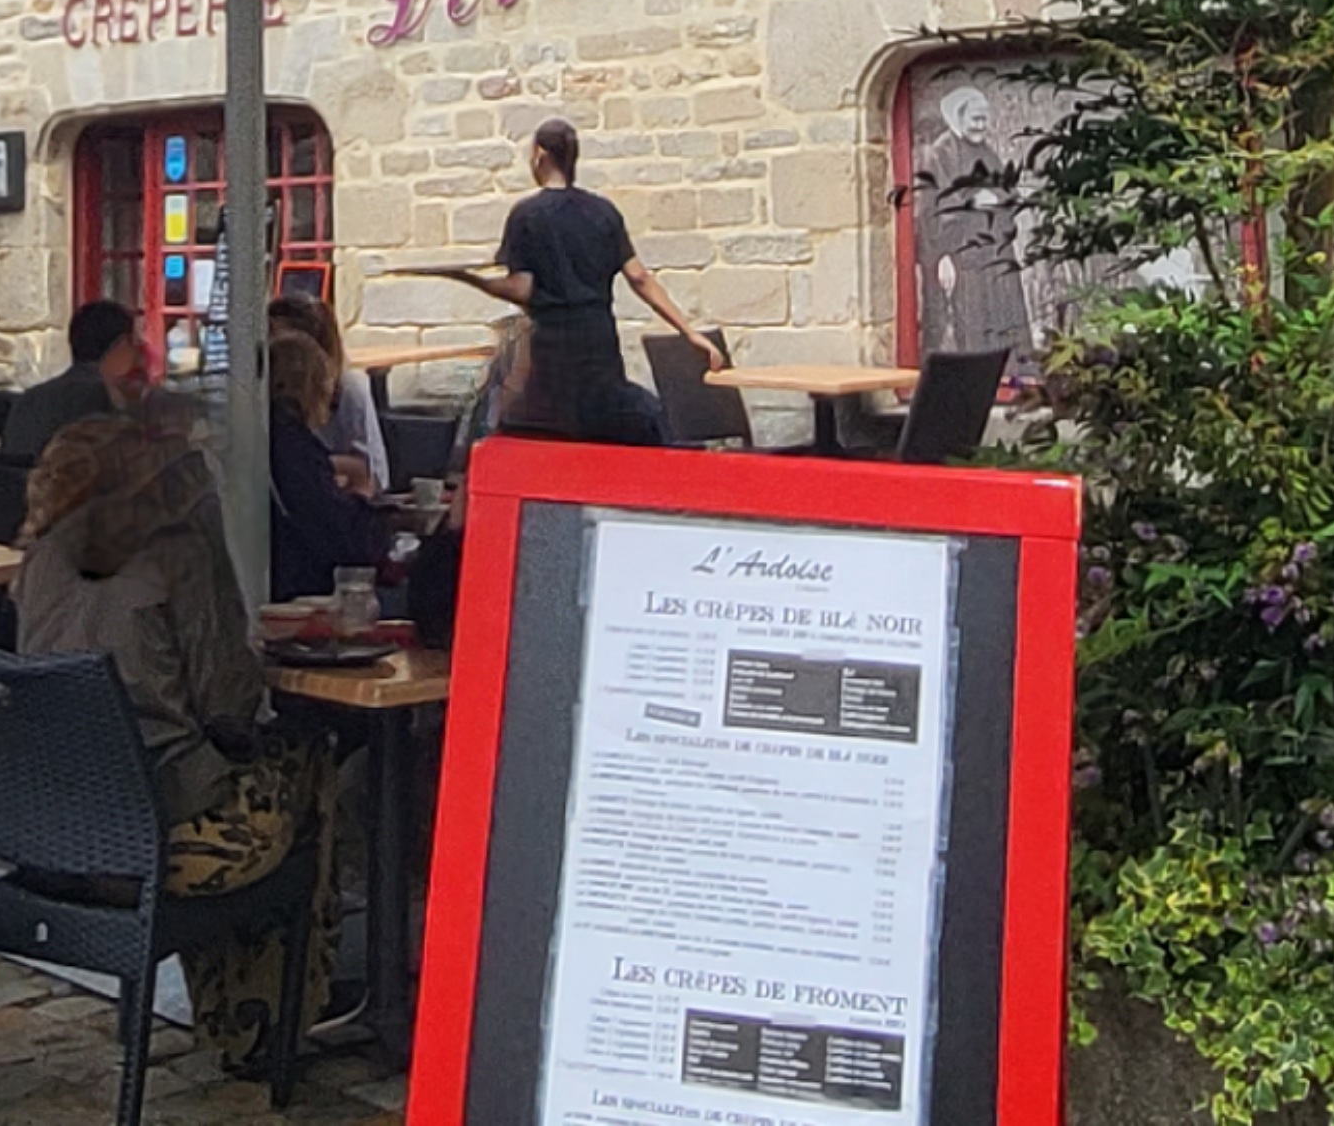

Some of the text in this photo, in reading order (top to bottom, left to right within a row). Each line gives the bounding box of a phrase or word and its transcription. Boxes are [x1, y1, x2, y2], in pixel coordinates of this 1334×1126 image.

[782, 607, 812, 626] DE
[865, 614, 923, 636] NOIR
[754, 979, 786, 1000] DE
[793, 984, 909, 1016] FROMENT
